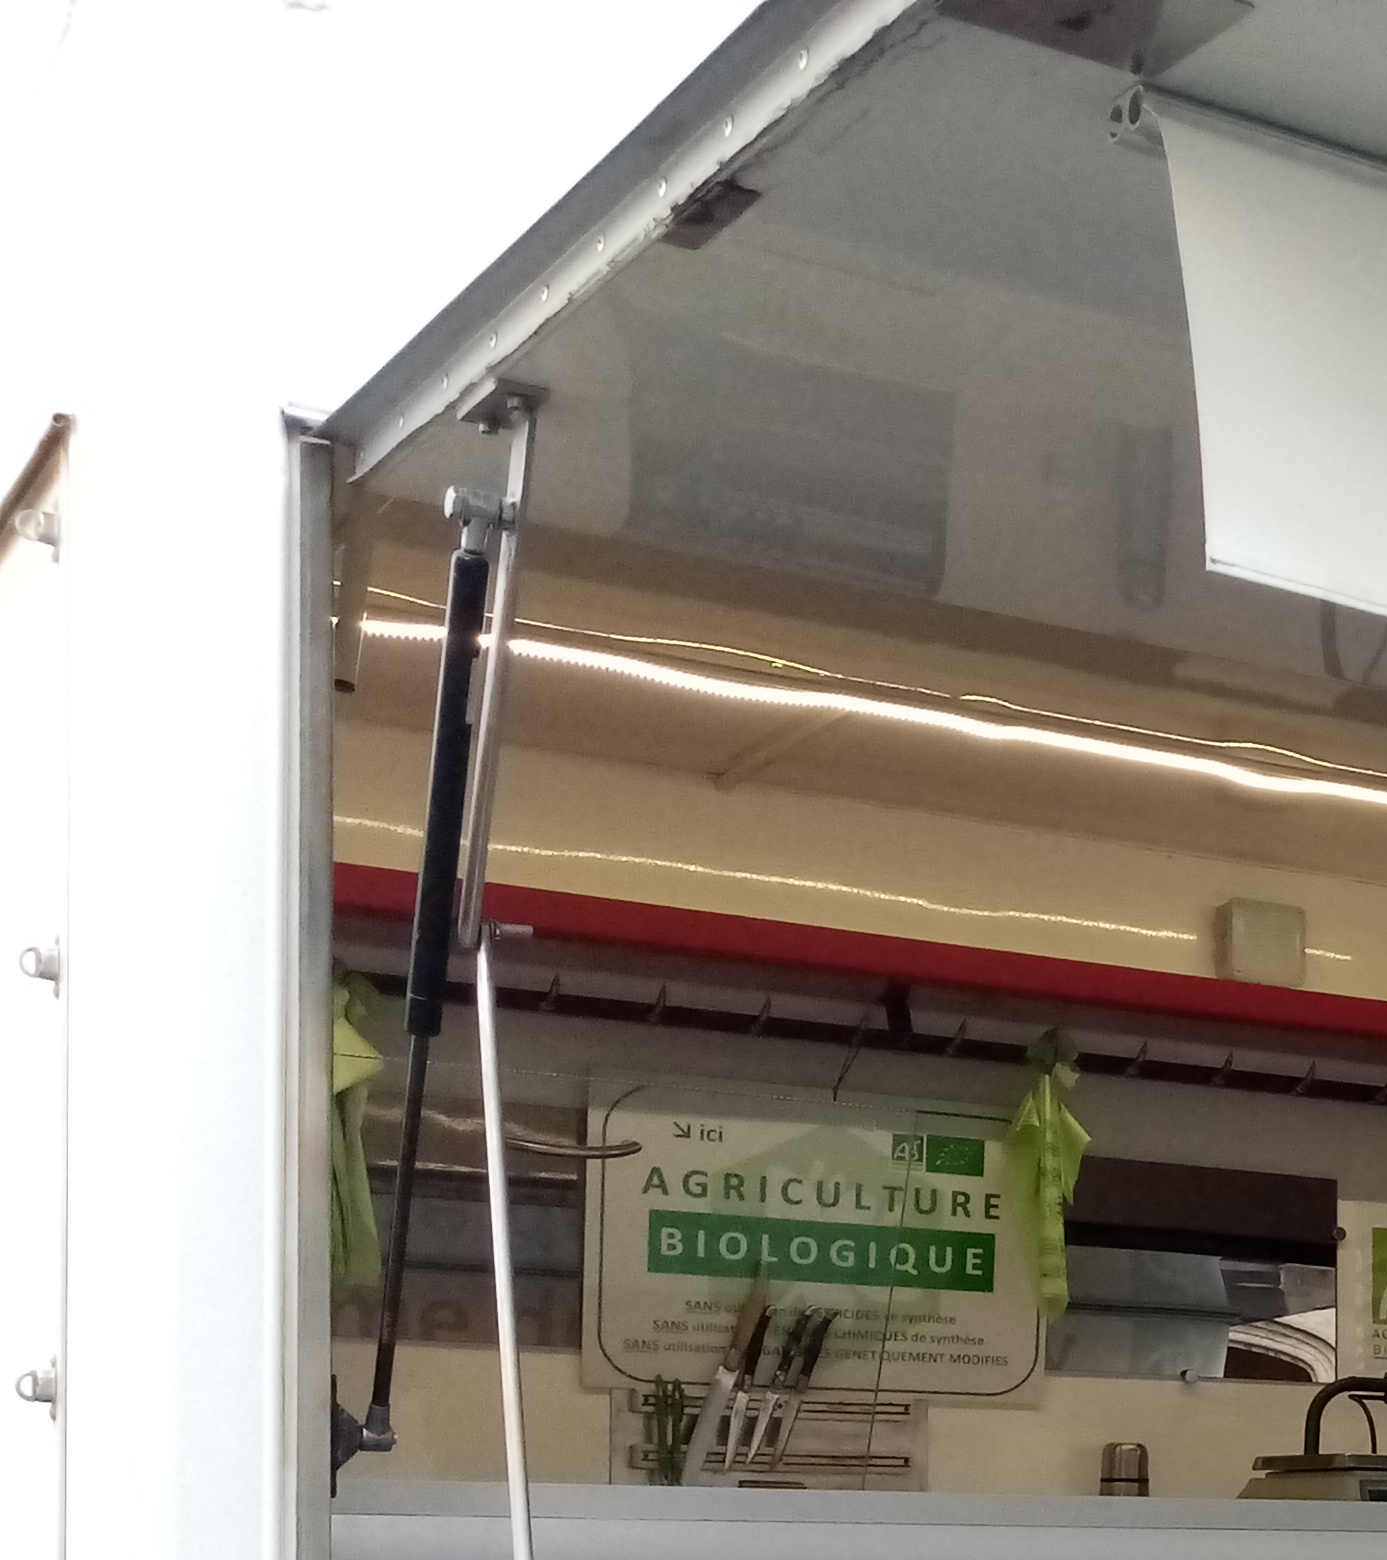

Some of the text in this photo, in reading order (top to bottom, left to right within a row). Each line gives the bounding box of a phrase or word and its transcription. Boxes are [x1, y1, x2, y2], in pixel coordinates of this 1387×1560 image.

[699, 1124, 723, 1143] ici
[643, 1167, 1001, 1220] AGRICULTURE
[661, 1227, 984, 1276] BIOLOGIQUE
[686, 1301, 720, 1313] SANS
[652, 1319, 688, 1332] SANS
[929, 1334, 985, 1347] synthèse
[622, 1339, 659, 1351] SANS
